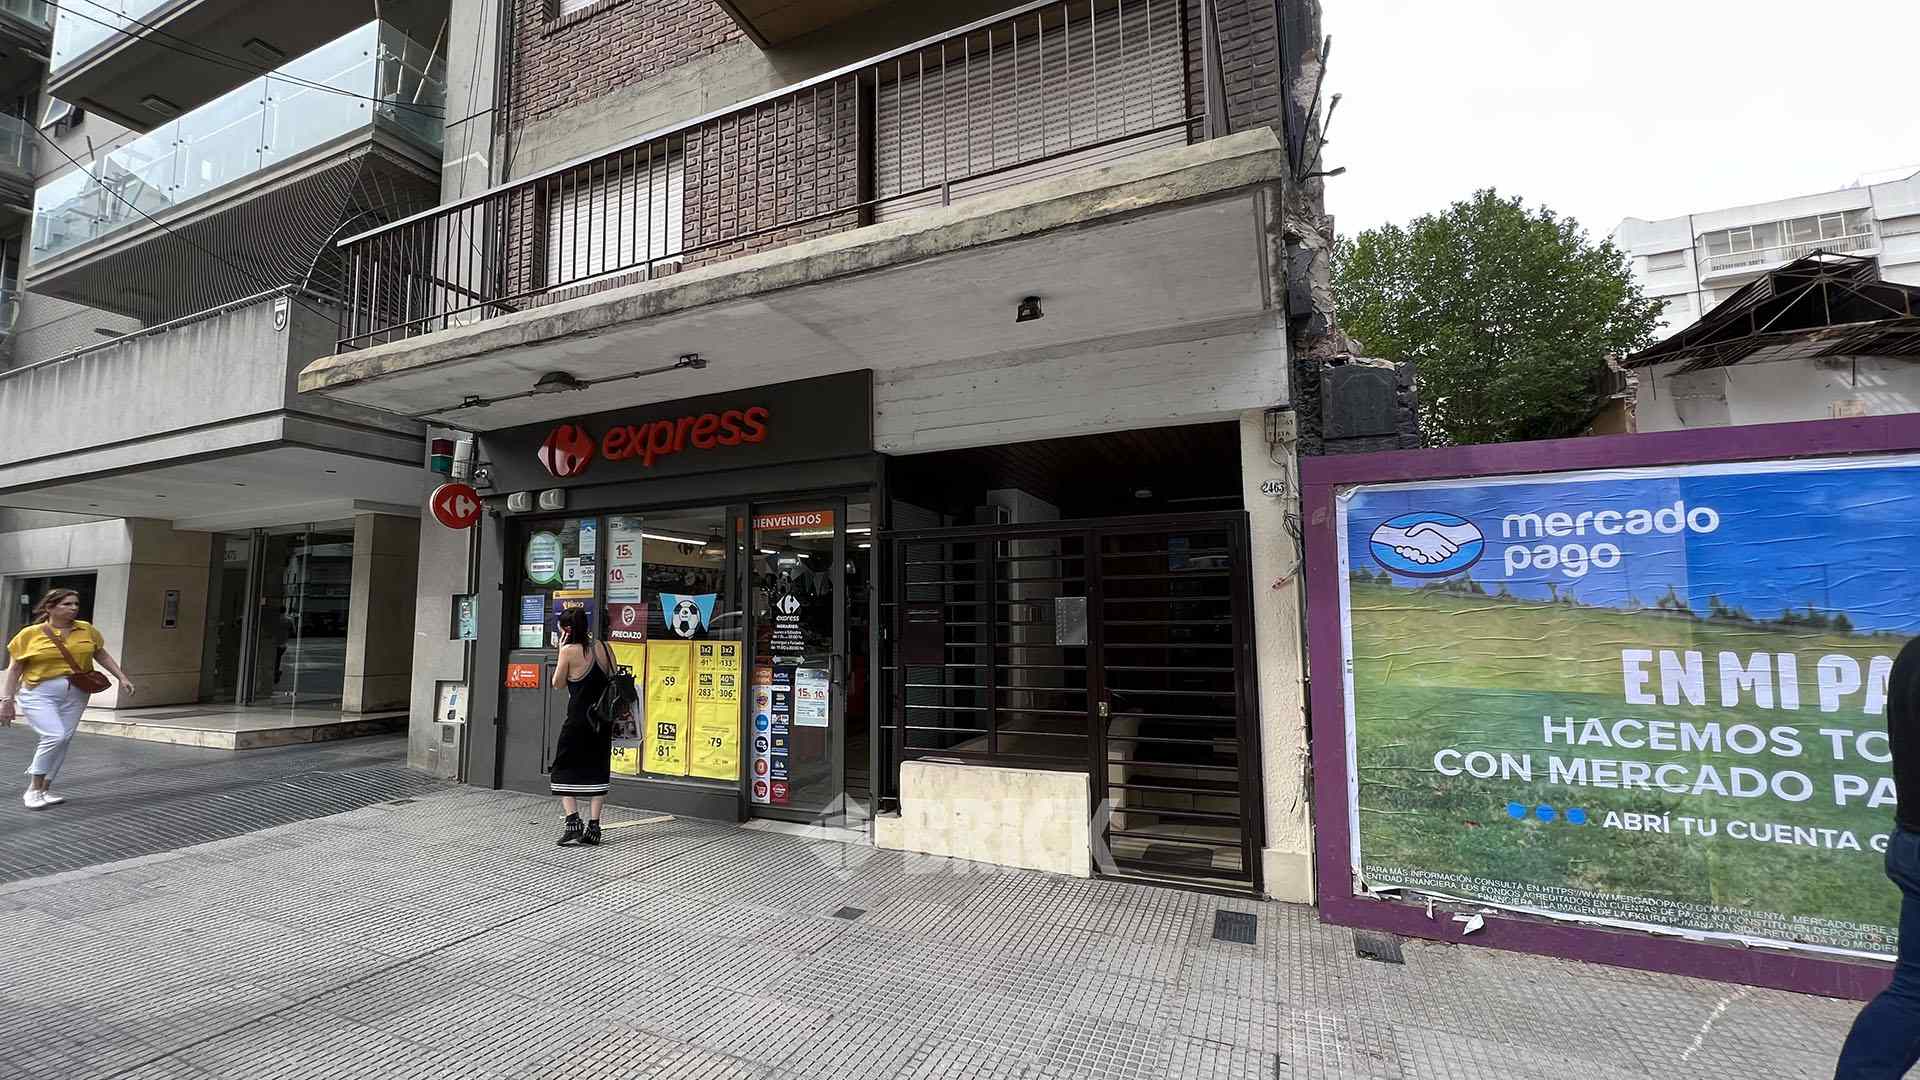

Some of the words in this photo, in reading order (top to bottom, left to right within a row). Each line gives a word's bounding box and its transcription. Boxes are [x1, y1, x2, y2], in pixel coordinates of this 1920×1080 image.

[602, 406, 769, 467] express
[1502, 500, 1720, 538] mercado
[1504, 542, 1621, 578] pago
[612, 630, 641, 639] PRECIAZO
[1622, 649, 1705, 706] EN
[1719, 651, 1799, 710] MI
[1543, 715, 1803, 757] HACEMOS
[1434, 750, 1532, 782] CON
[1549, 755, 1814, 801] MERCADO
[1602, 811, 1671, 834] ABRÍ
[1677, 817, 1717, 837] TU
[1726, 820, 1862, 851] CUENTA
[1366, 865, 1388, 874] PARA
[1474, 877, 1524, 890] CONSULTA
[1526, 884, 1540, 892] EN
[1793, 915, 1888, 935] MERCADOLIBRE
[1366, 872, 1402, 883] ENTIDAD
[1461, 883, 1480, 892] LOS
[1481, 885, 1521, 897] FONDOS
[1522, 891, 1591, 906] ACREDITADOS
[1593, 900, 1607, 908] EN
[1610, 901, 1658, 915] CUENTAS
[1660, 908, 1675, 917] DE
[1678, 910, 1708, 921] PAGO
[1711, 914, 1726, 922] NO
[1728, 916, 1810, 933] CONSTITUYEN
[1557, 903, 1596, 914] IMAGEN
[1716, 921, 1730, 930] HA
[1733, 924, 1760, 934] SIDO
[1763, 928, 1828, 944] RETOCADA
